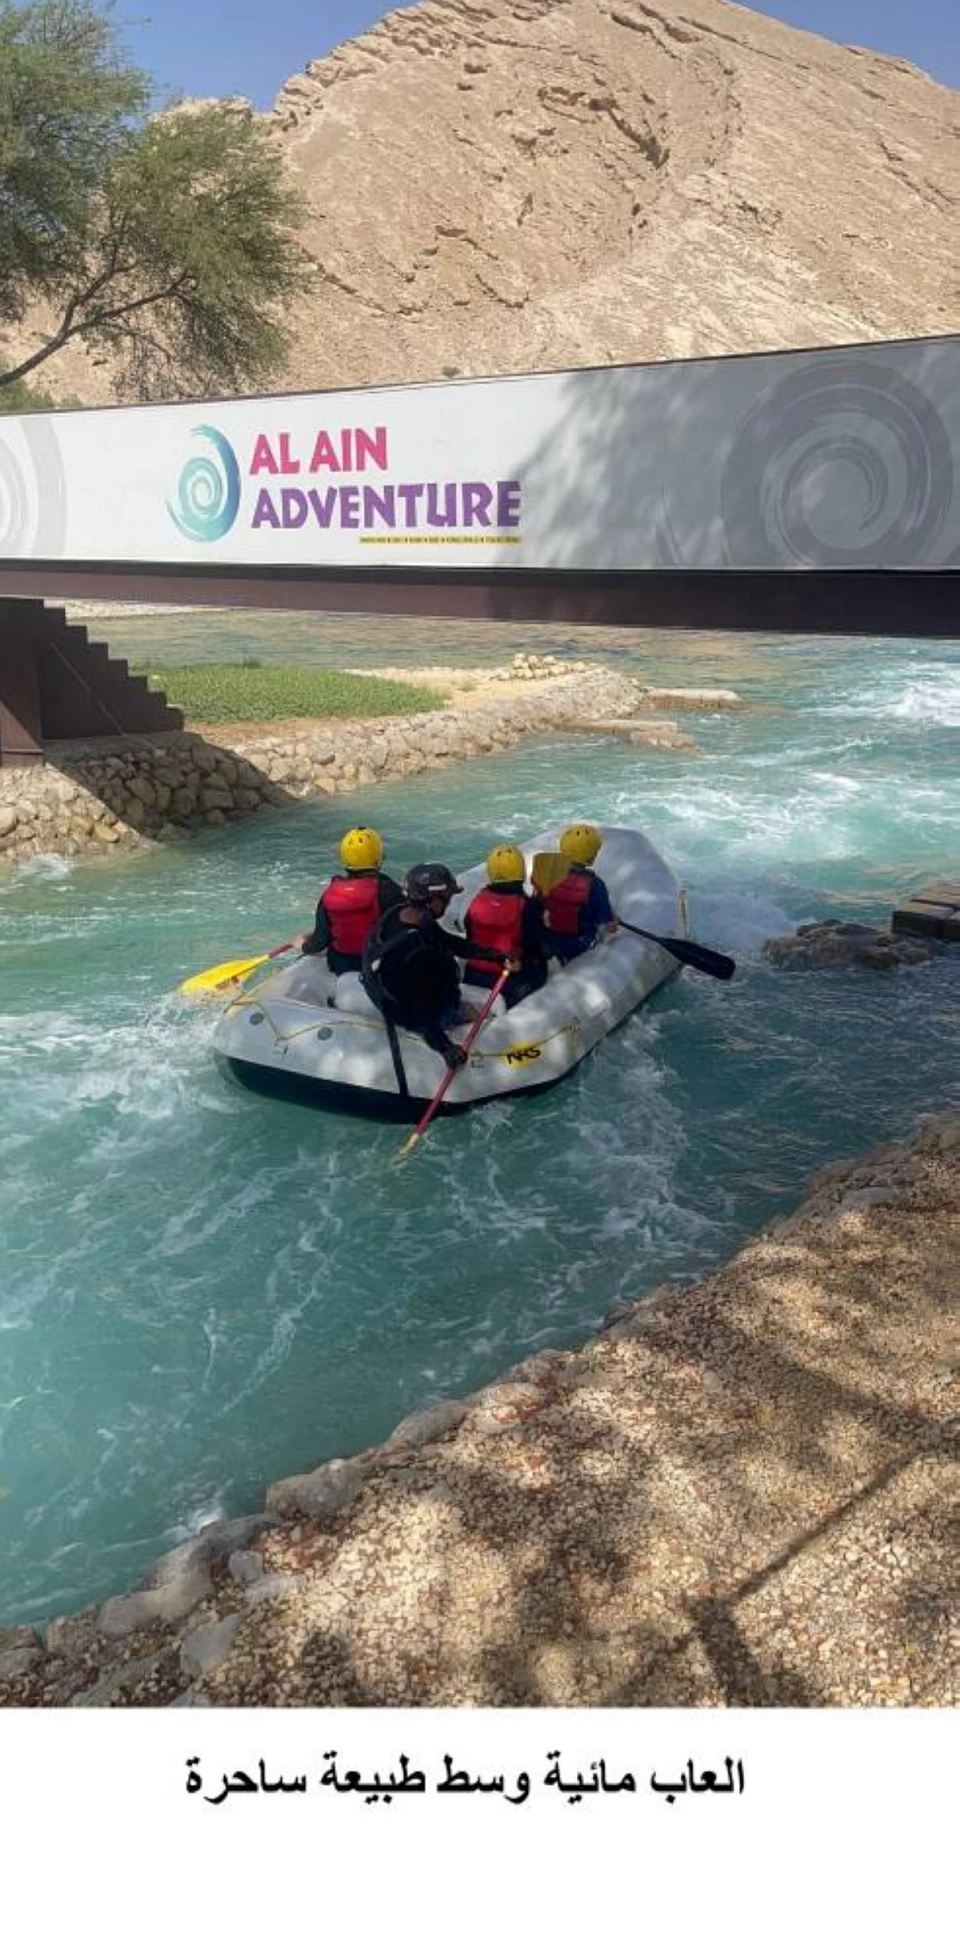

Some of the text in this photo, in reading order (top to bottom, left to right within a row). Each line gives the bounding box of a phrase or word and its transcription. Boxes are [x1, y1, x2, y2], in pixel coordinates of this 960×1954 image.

[250, 427, 388, 475] AL AIN
[251, 480, 522, 529] ADVENTURE
